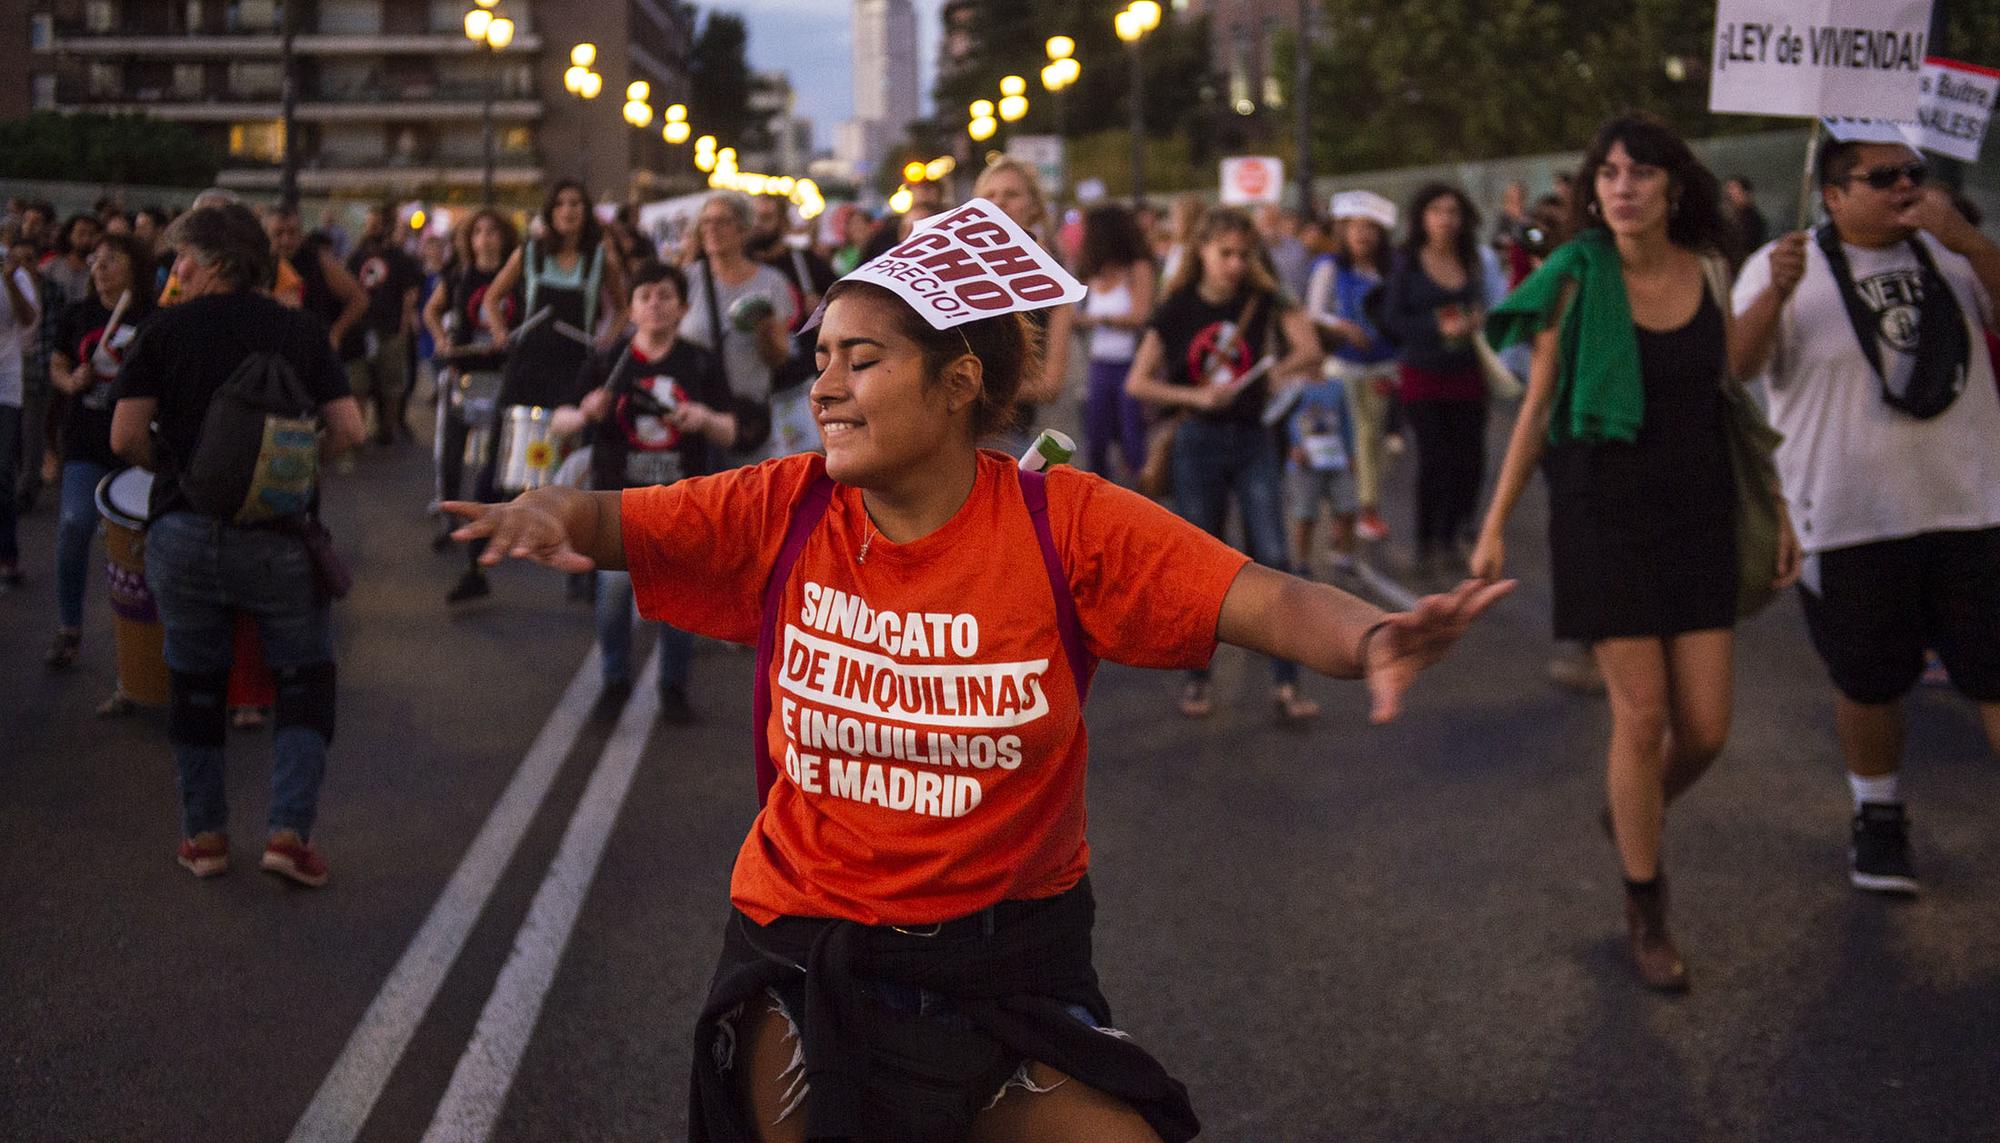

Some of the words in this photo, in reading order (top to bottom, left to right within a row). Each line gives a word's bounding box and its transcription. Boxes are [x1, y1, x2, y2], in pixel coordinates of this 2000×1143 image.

[1776, 25, 1804, 65] de
[1809, 26, 1923, 72] VIVIENDA!
[864, 259, 971, 319] PRECIO!
[787, 638, 830, 692] DE
[832, 655, 1041, 717] INQUILINAS
[782, 696, 797, 741] E
[800, 707, 1022, 770] INQUILINOS
[785, 741, 822, 794] DE
[829, 758, 982, 818] MADRID
